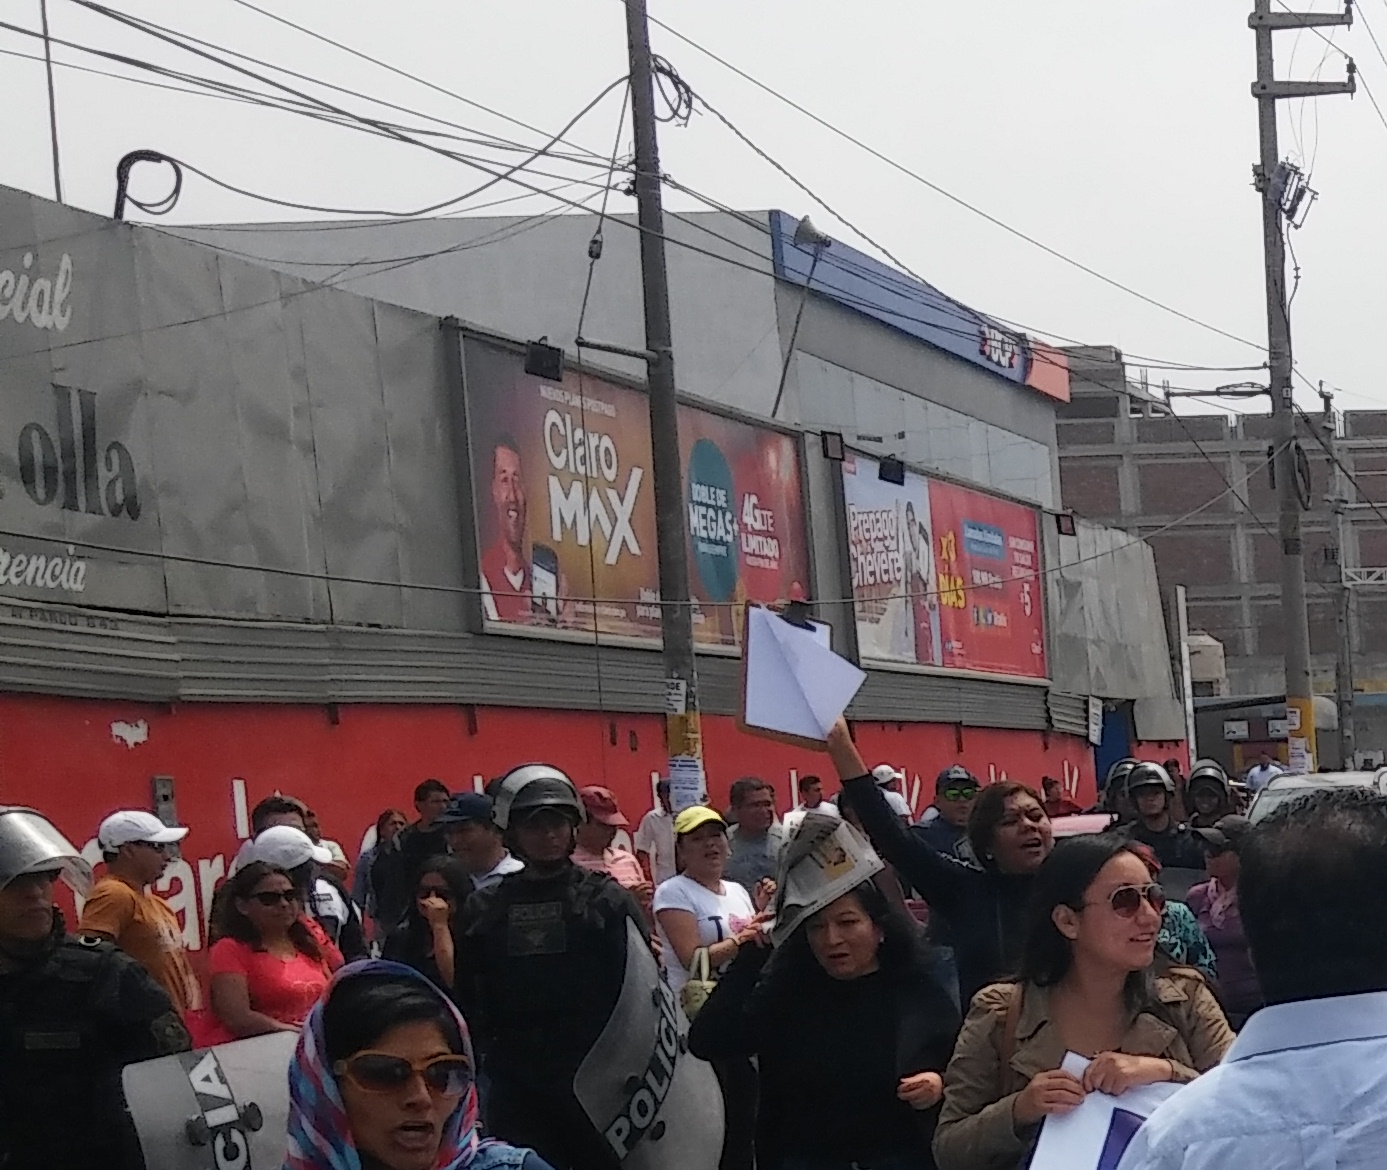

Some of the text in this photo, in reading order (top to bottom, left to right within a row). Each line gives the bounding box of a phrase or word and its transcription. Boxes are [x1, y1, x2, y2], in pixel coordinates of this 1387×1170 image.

[18, 384, 142, 521] olla
[543, 408, 618, 483] Claro
[549, 465, 644, 567] MAX
[605, 977, 677, 1161] POLICIA
